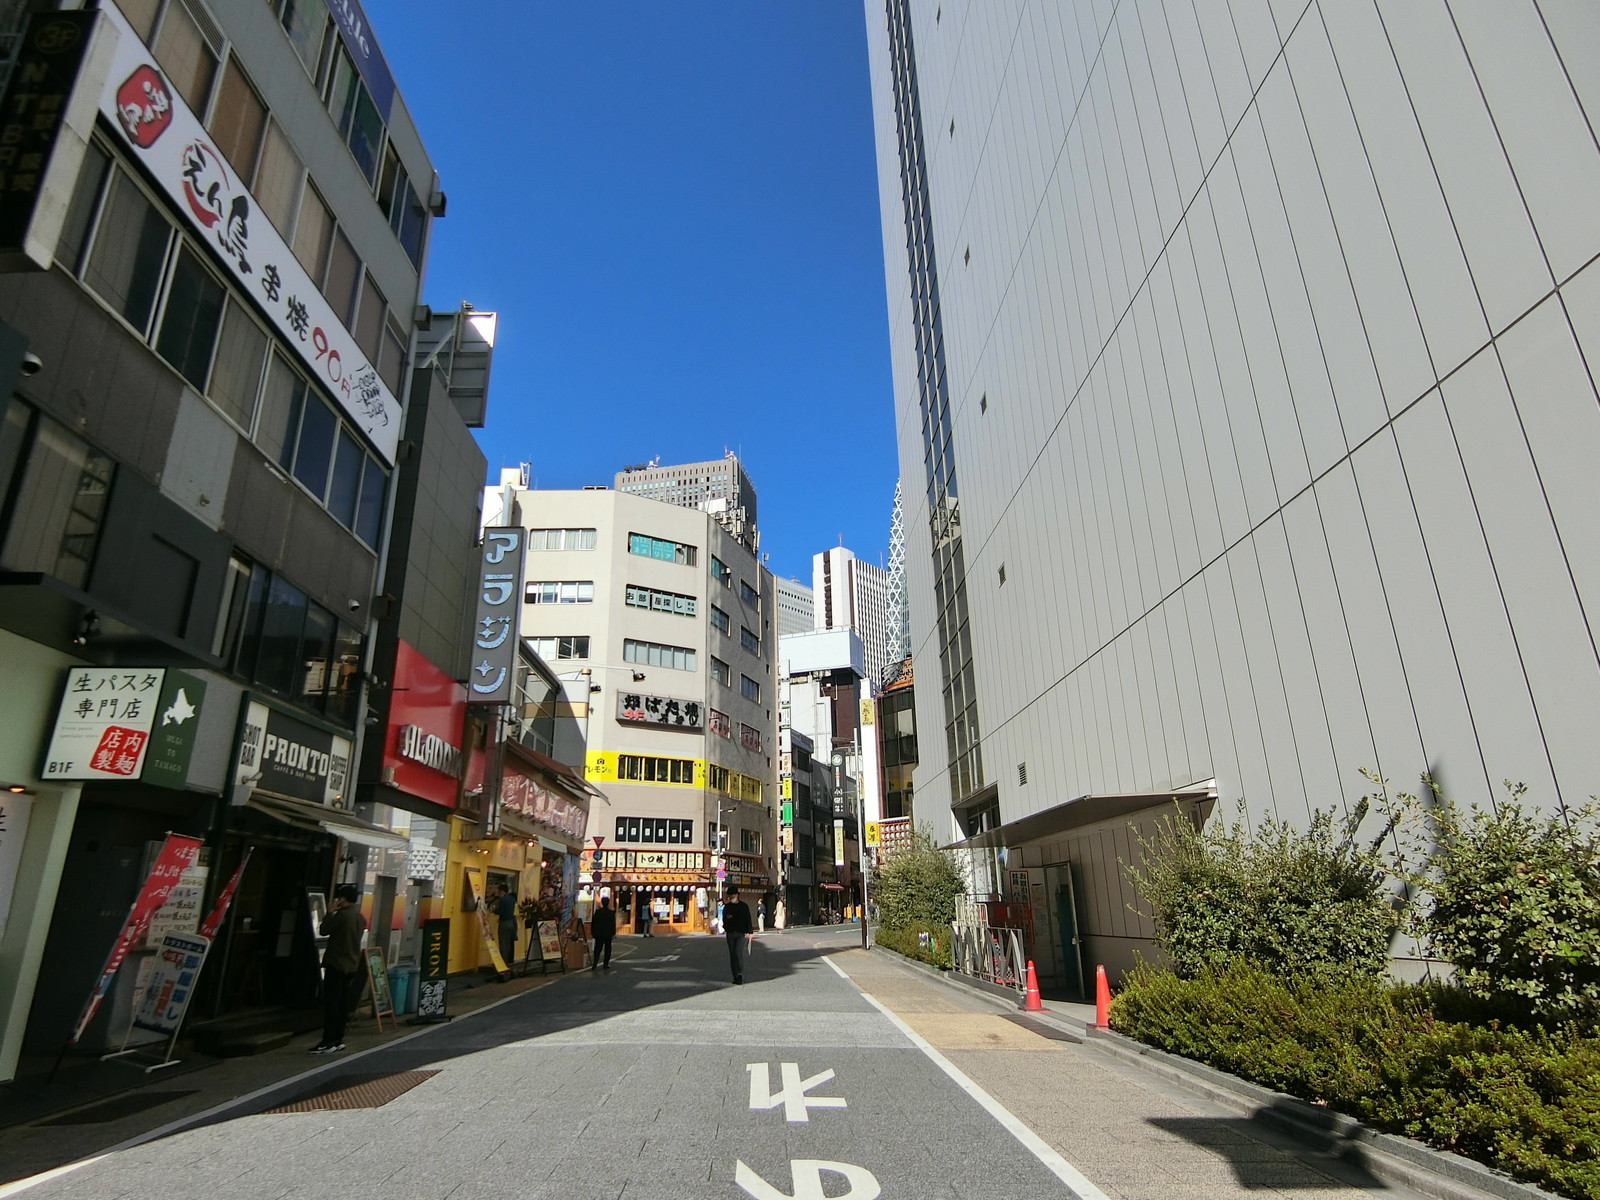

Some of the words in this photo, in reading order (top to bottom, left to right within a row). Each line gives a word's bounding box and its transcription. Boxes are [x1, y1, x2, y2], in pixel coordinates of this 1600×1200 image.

[627, 591, 683, 609] お部屋探し
[473, 533, 519, 694] アラジン
[72, 673, 158, 693] 生パスタ
[74, 697, 142, 719] 専門店
[101, 729, 142, 751] 店内
[244, 724, 262, 747] SHOT
[94, 750, 136, 775] 製麺
[241, 745, 256, 767] BAR
[263, 733, 329, 777] PRONTO
[331, 754, 347, 775] COFFEE
[48, 761, 74, 774] B1F
[330, 772, 343, 791] SHOP
[428, 931, 442, 977] PRON
